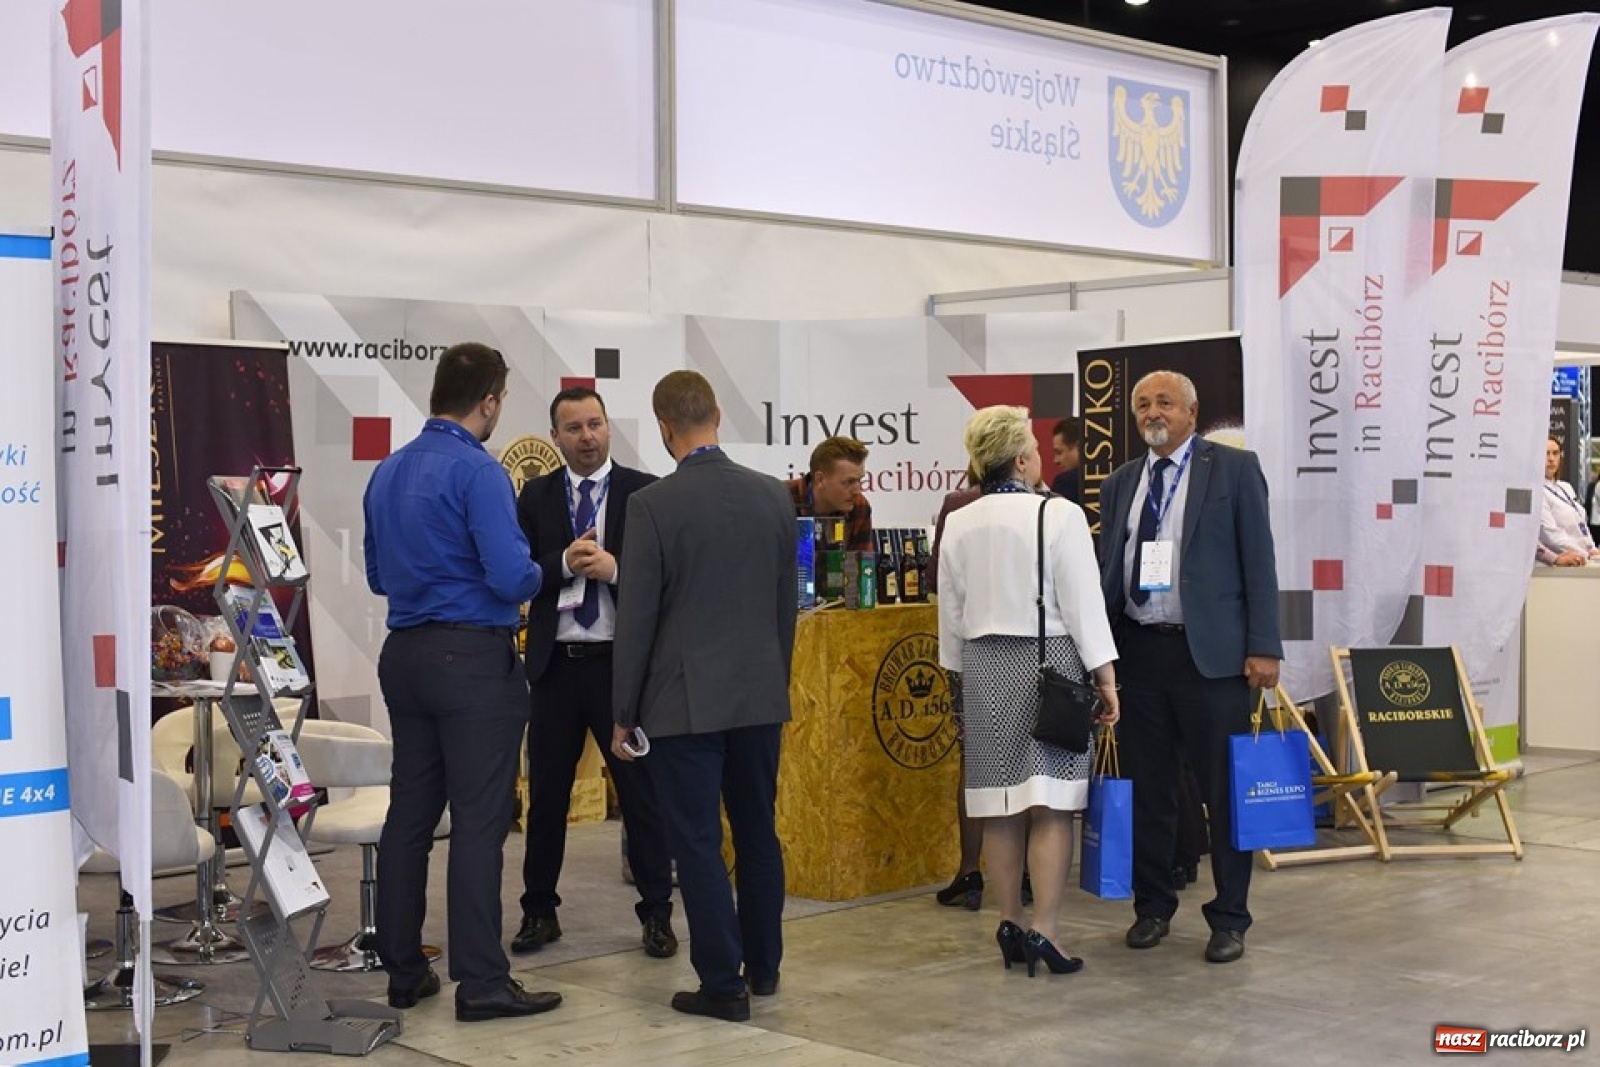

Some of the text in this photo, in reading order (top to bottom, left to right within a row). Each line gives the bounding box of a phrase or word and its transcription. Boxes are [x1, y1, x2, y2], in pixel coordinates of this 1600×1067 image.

[1297, 328, 1341, 478] Invest
[1354, 274, 1384, 453] in Racibórz
[1423, 332, 1463, 478] Invest
[1470, 280, 1511, 460] in Racibórz
[761, 401, 921, 446] Invest
[860, 460, 970, 493] acibórz
[1367, 708, 1454, 722] RACIBORSKIE
[20, 784, 56, 803] 4x4
